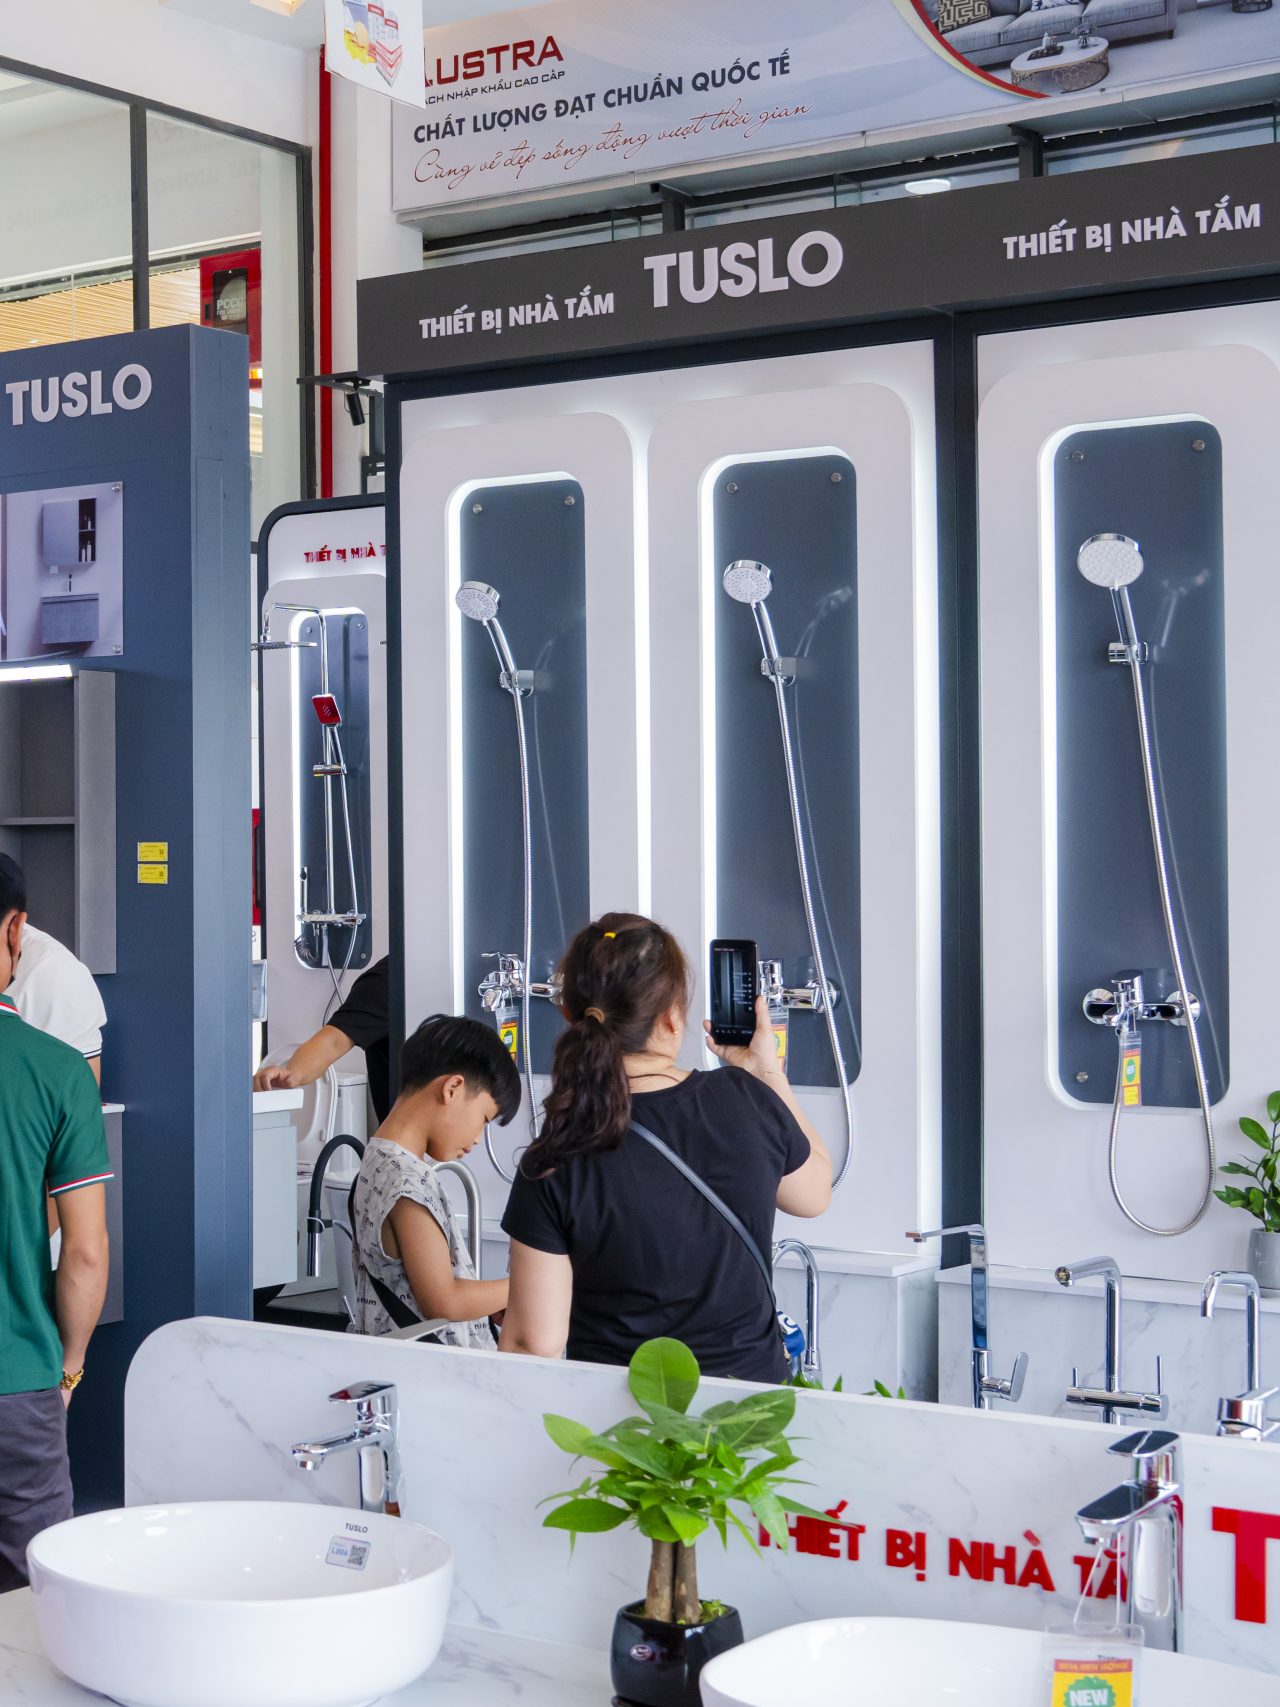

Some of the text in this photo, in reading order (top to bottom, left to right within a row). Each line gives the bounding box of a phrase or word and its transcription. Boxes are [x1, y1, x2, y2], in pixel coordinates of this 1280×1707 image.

[413, 48, 790, 144] CHẤT LƯỢNG ĐẠT CHUẨN QUỐC TẾ
[447, 87, 479, 101] NHẬP
[480, 78, 512, 94] KHẨU
[514, 77, 539, 88] CAO
[541, 69, 566, 83] CẤP
[414, 148, 476, 190] Càng
[503, 139, 536, 179] đẹp
[542, 138, 593, 170] sống
[595, 122, 652, 160] động
[710, 97, 754, 131] thời
[743, 103, 814, 139] gian
[1002, 194, 1262, 260] THIẾT BỊ NHÀ TẮM
[419, 230, 844, 339] THIẾT BỊ NHÀ TẮM TUSLO
[5, 363, 153, 426] TUSLO
[345, 1522, 368, 1534] TUSLO
[885, 1528, 927, 1582] BỊ
[948, 1529, 1056, 1592] NHÀ
[1069, 1688, 1108, 1707] NEW
